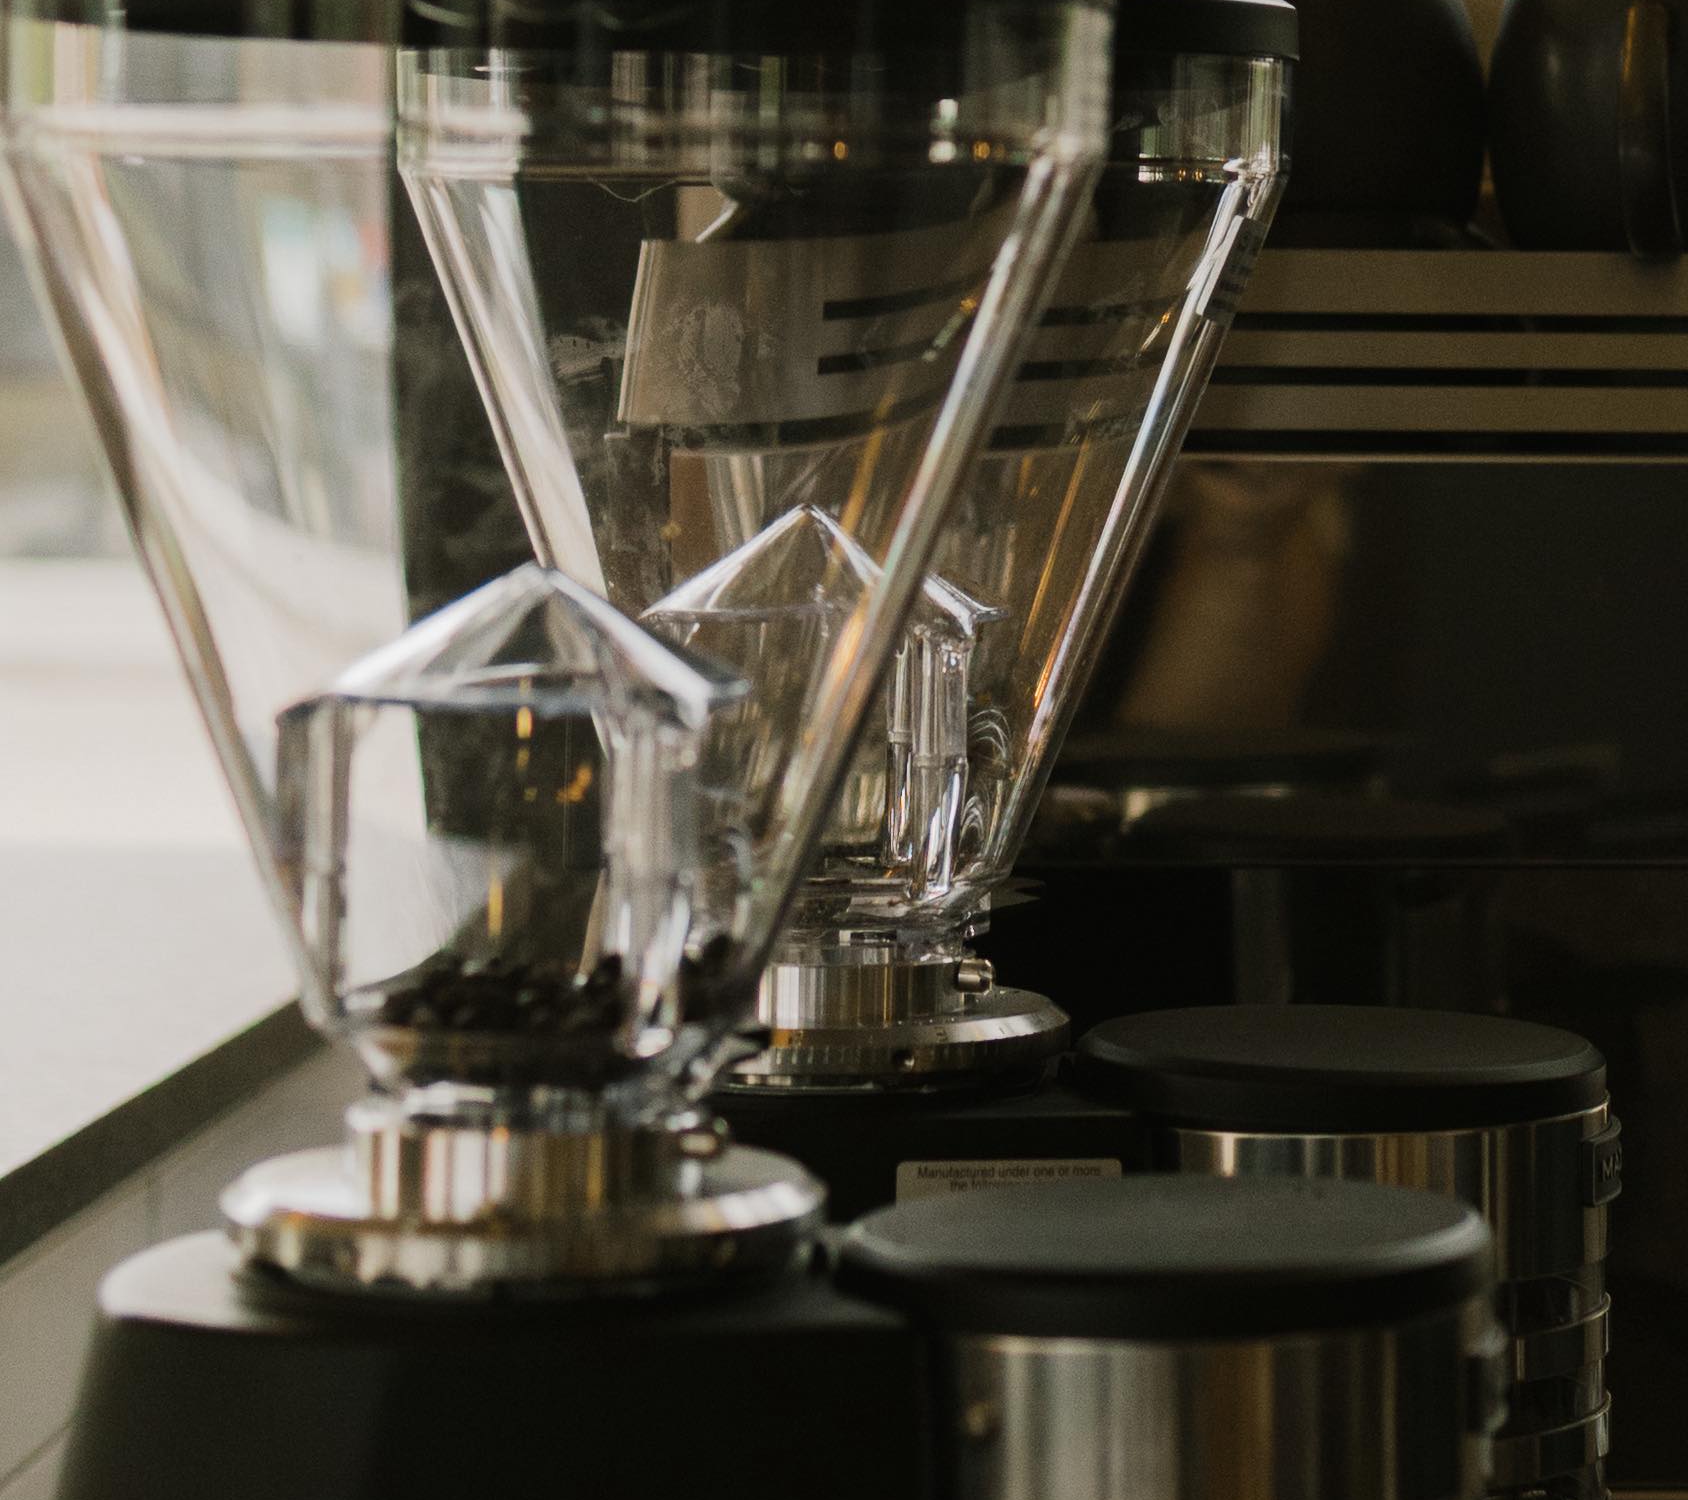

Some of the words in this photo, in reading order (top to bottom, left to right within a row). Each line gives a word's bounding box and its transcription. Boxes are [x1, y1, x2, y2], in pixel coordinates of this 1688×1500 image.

[917, 1166, 995, 1178] Manufactured
[998, 1166, 1029, 1177] under
[1033, 1166, 1054, 1176] one
[1058, 1166, 1070, 1176] or
[1073, 1165, 1101, 1176] more
[950, 1180, 967, 1191] the
